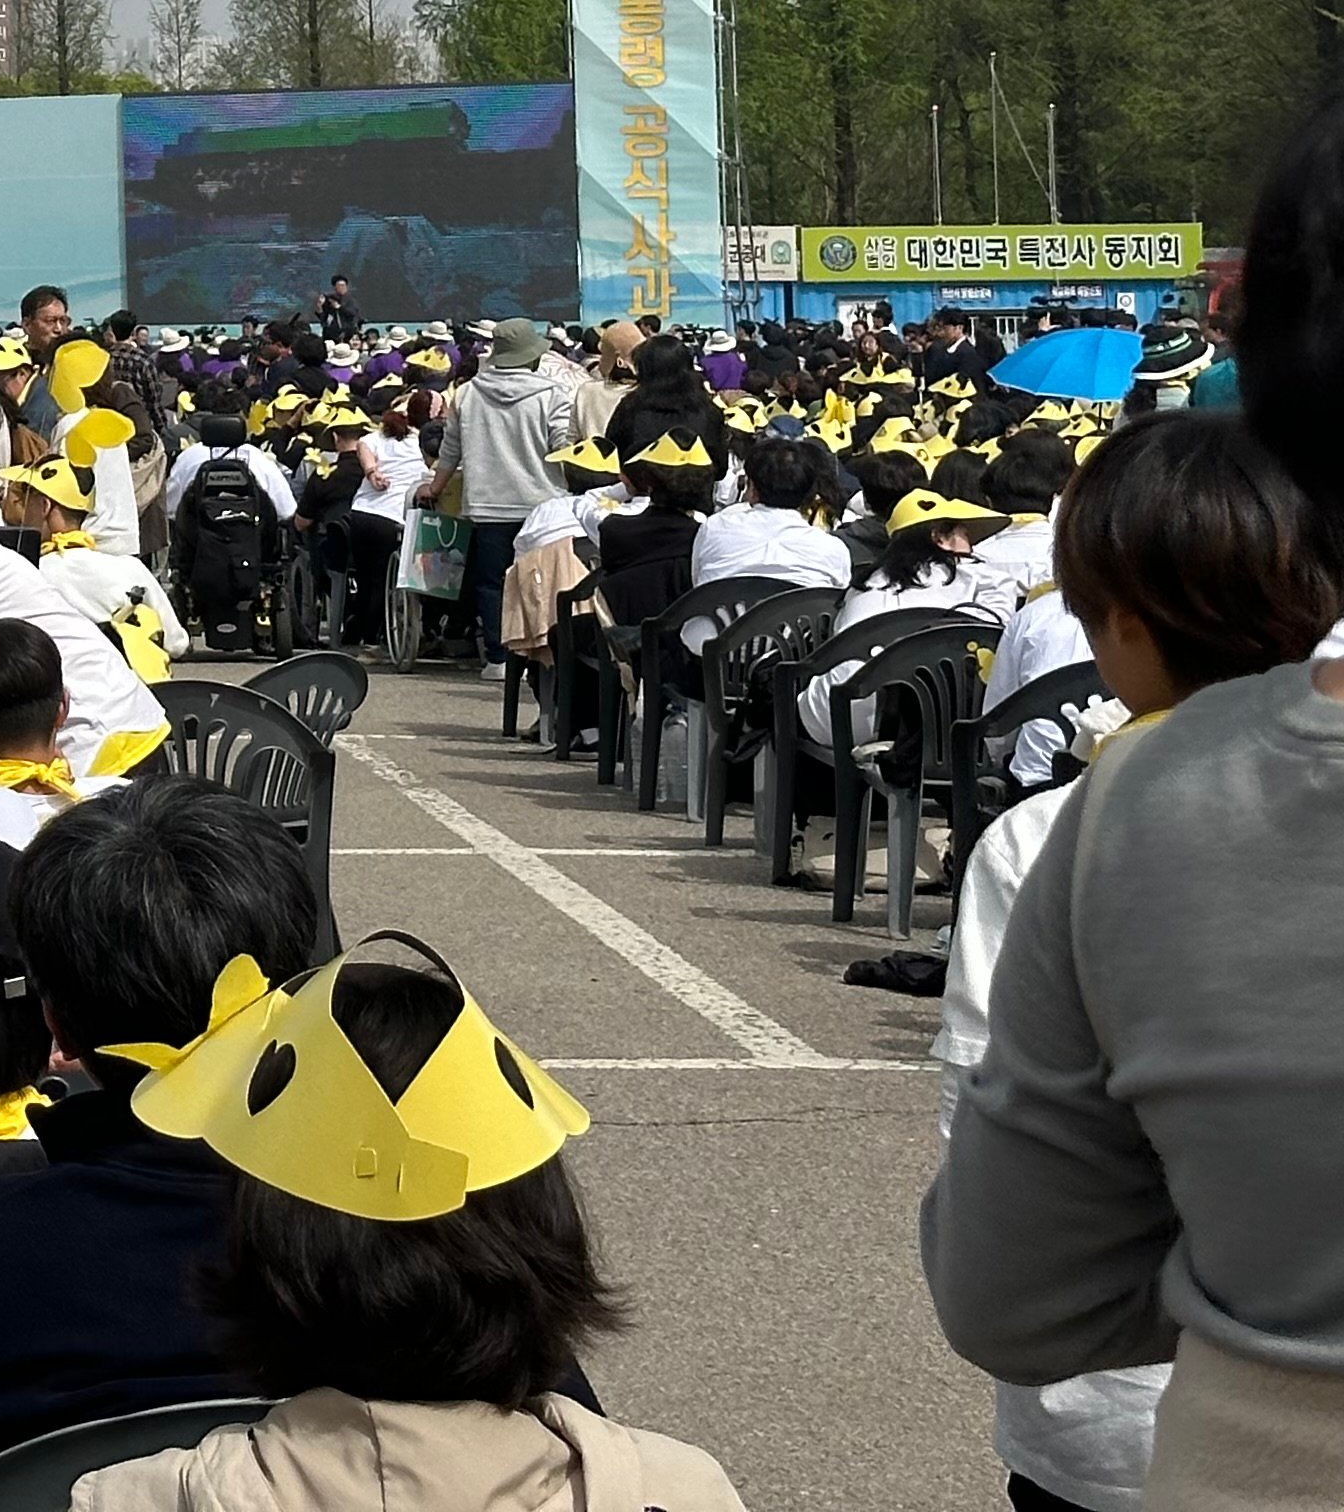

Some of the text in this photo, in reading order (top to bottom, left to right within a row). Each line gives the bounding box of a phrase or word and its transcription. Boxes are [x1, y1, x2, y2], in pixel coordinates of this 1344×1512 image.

[619, 104, 677, 318] 공식사과
[865, 237, 895, 253] 사단
[906, 235, 1181, 269] 대한민국 특전사 동지회
[866, 254, 895, 269] 법인
